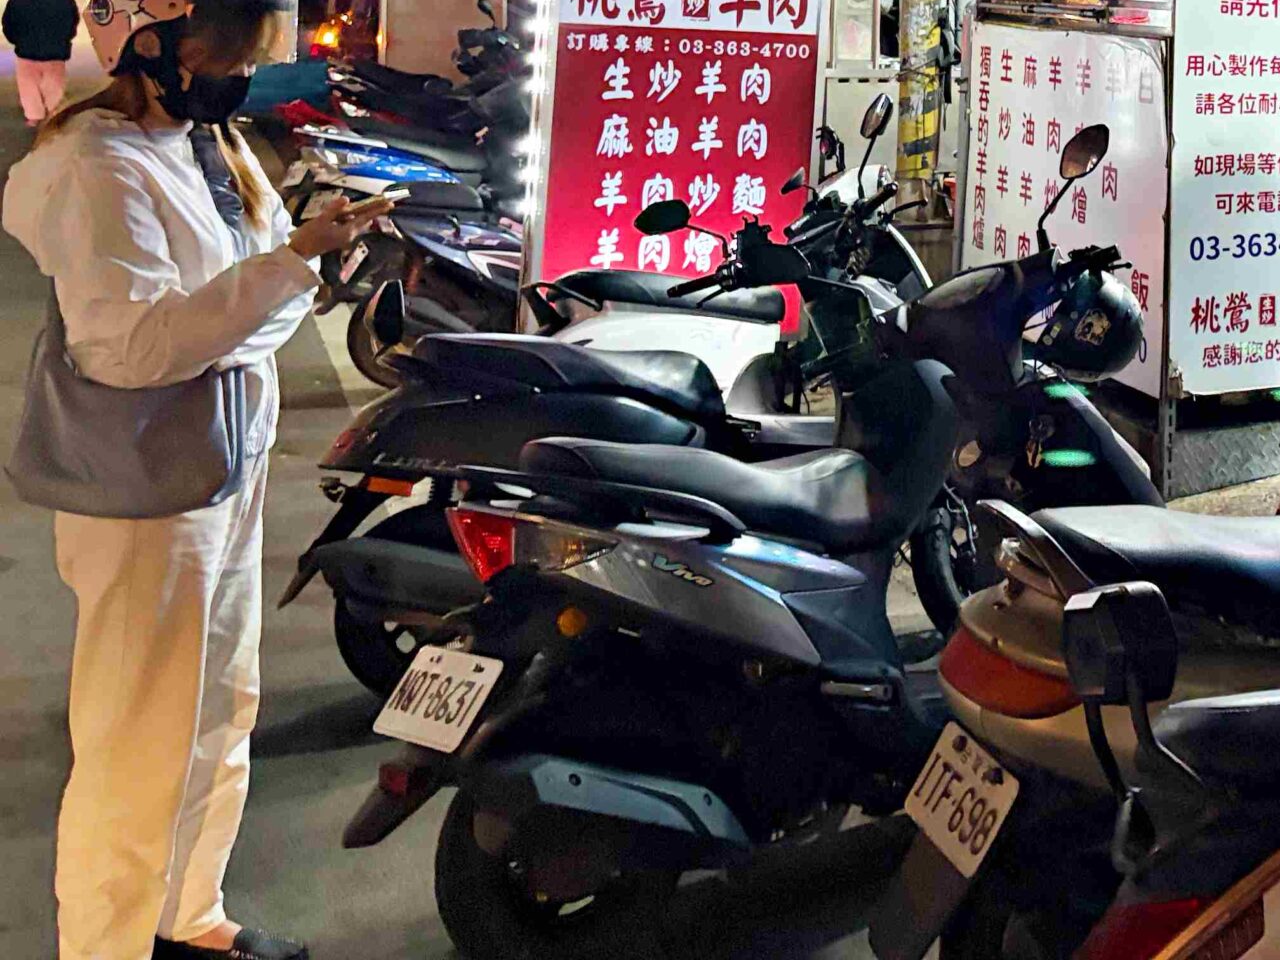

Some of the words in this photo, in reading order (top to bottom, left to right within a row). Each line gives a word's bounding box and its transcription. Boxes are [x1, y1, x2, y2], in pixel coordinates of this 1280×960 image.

[679, 39, 811, 60] 03-363-4700
[601, 57, 772, 106] 生炒羊肉
[596, 114, 769, 161] 麻油羊肉
[994, 48, 1014, 259] 生炒羊肉
[1043, 55, 1062, 248] 羊肉炒
[594, 170, 768, 218] 羊肉炒麵
[589, 229, 739, 274] 羊肉燴
